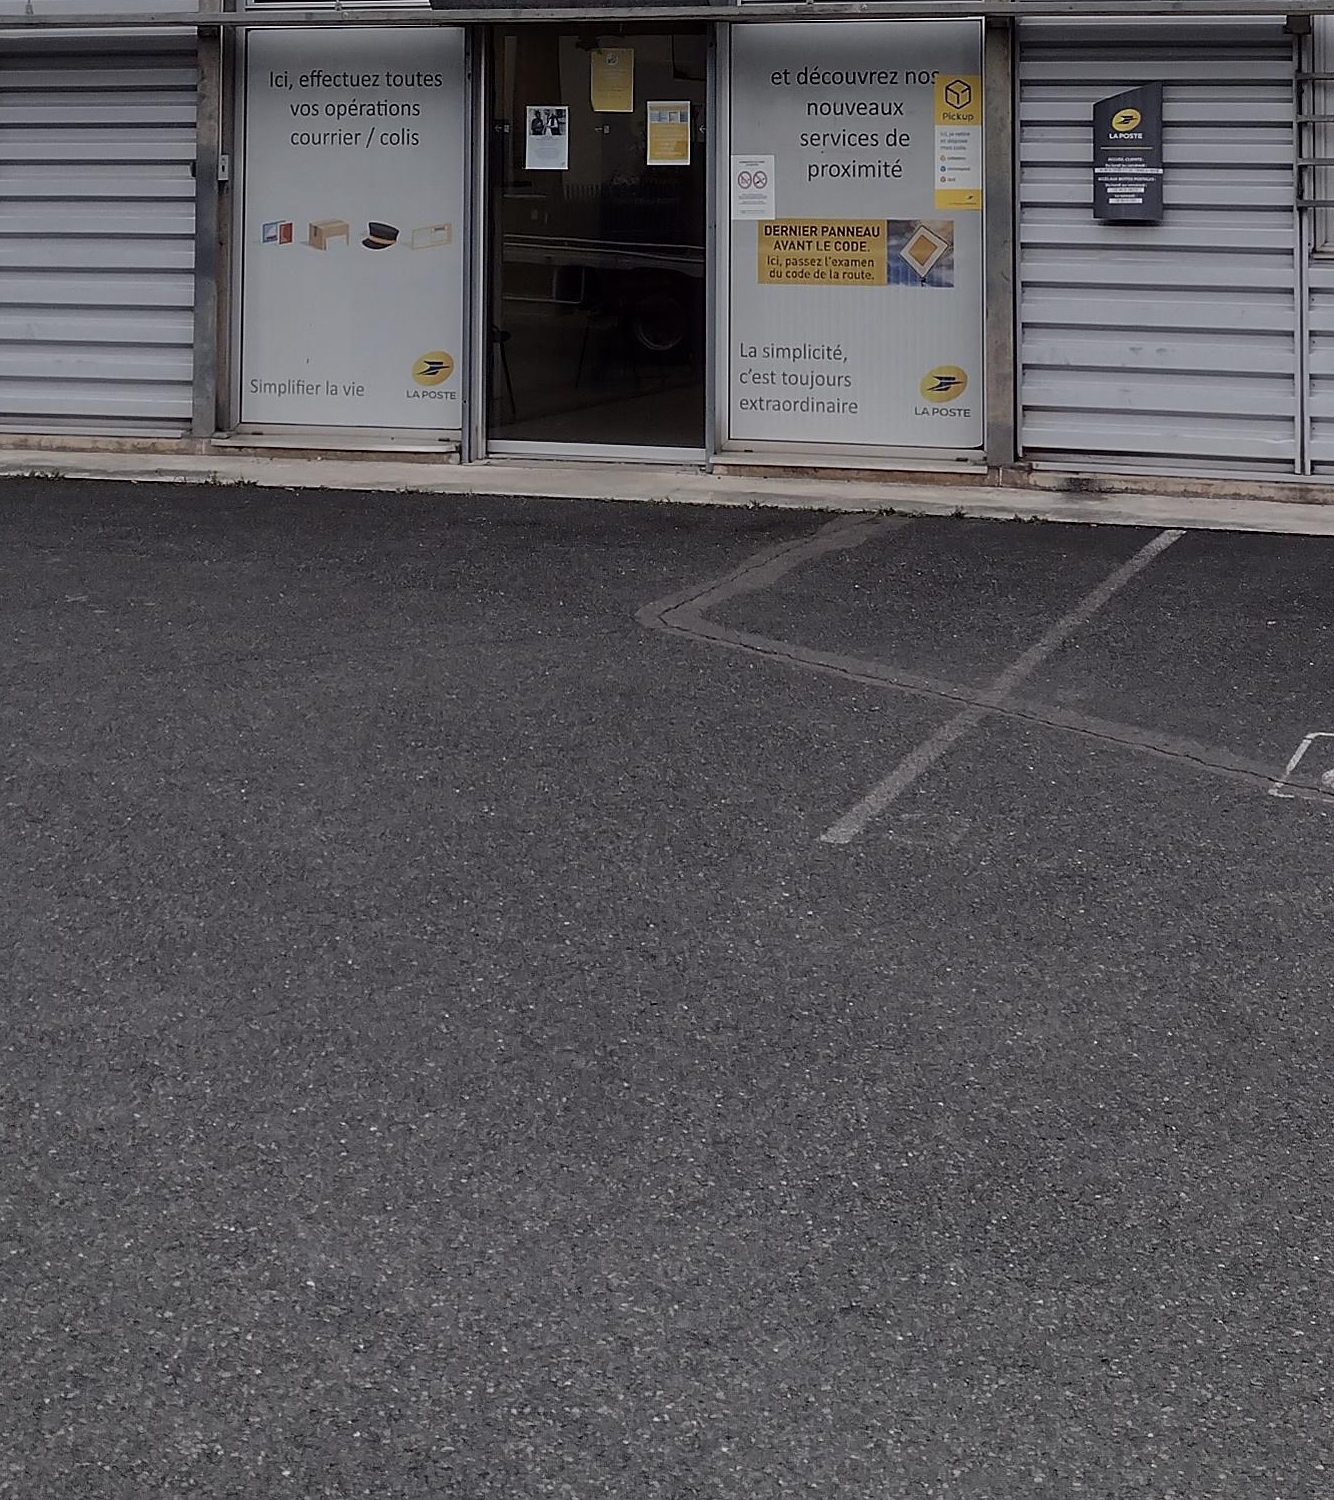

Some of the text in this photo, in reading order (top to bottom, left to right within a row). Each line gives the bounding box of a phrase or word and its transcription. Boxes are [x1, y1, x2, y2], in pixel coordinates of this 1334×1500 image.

[269, 69, 442, 91] Ici, effectuez toutes
[770, 69, 790, 86] et
[796, 66, 898, 86] découvrez
[290, 97, 421, 121] vos opérations
[807, 101, 904, 116] nouveaux
[943, 113, 974, 121] Pickup
[290, 128, 420, 148] courrier / colis
[800, 129, 911, 147] services de
[807, 159, 902, 182] proximité
[765, 225, 880, 237] DERNIER PANNEAU
[773, 241, 870, 252] AVANT LE CODE.
[767, 256, 782, 267] Ici,
[785, 257, 822, 268] passez
[770, 269, 874, 280] du code de la route.
[740, 342, 847, 364] La simplicité,
[250, 378, 365, 401] Simplifier la vie
[740, 368, 851, 392] c'est toujours
[406, 390, 456, 400] LA POSTE
[739, 395, 858, 415] extraordinaire
[915, 407, 971, 418] LA POSTE
